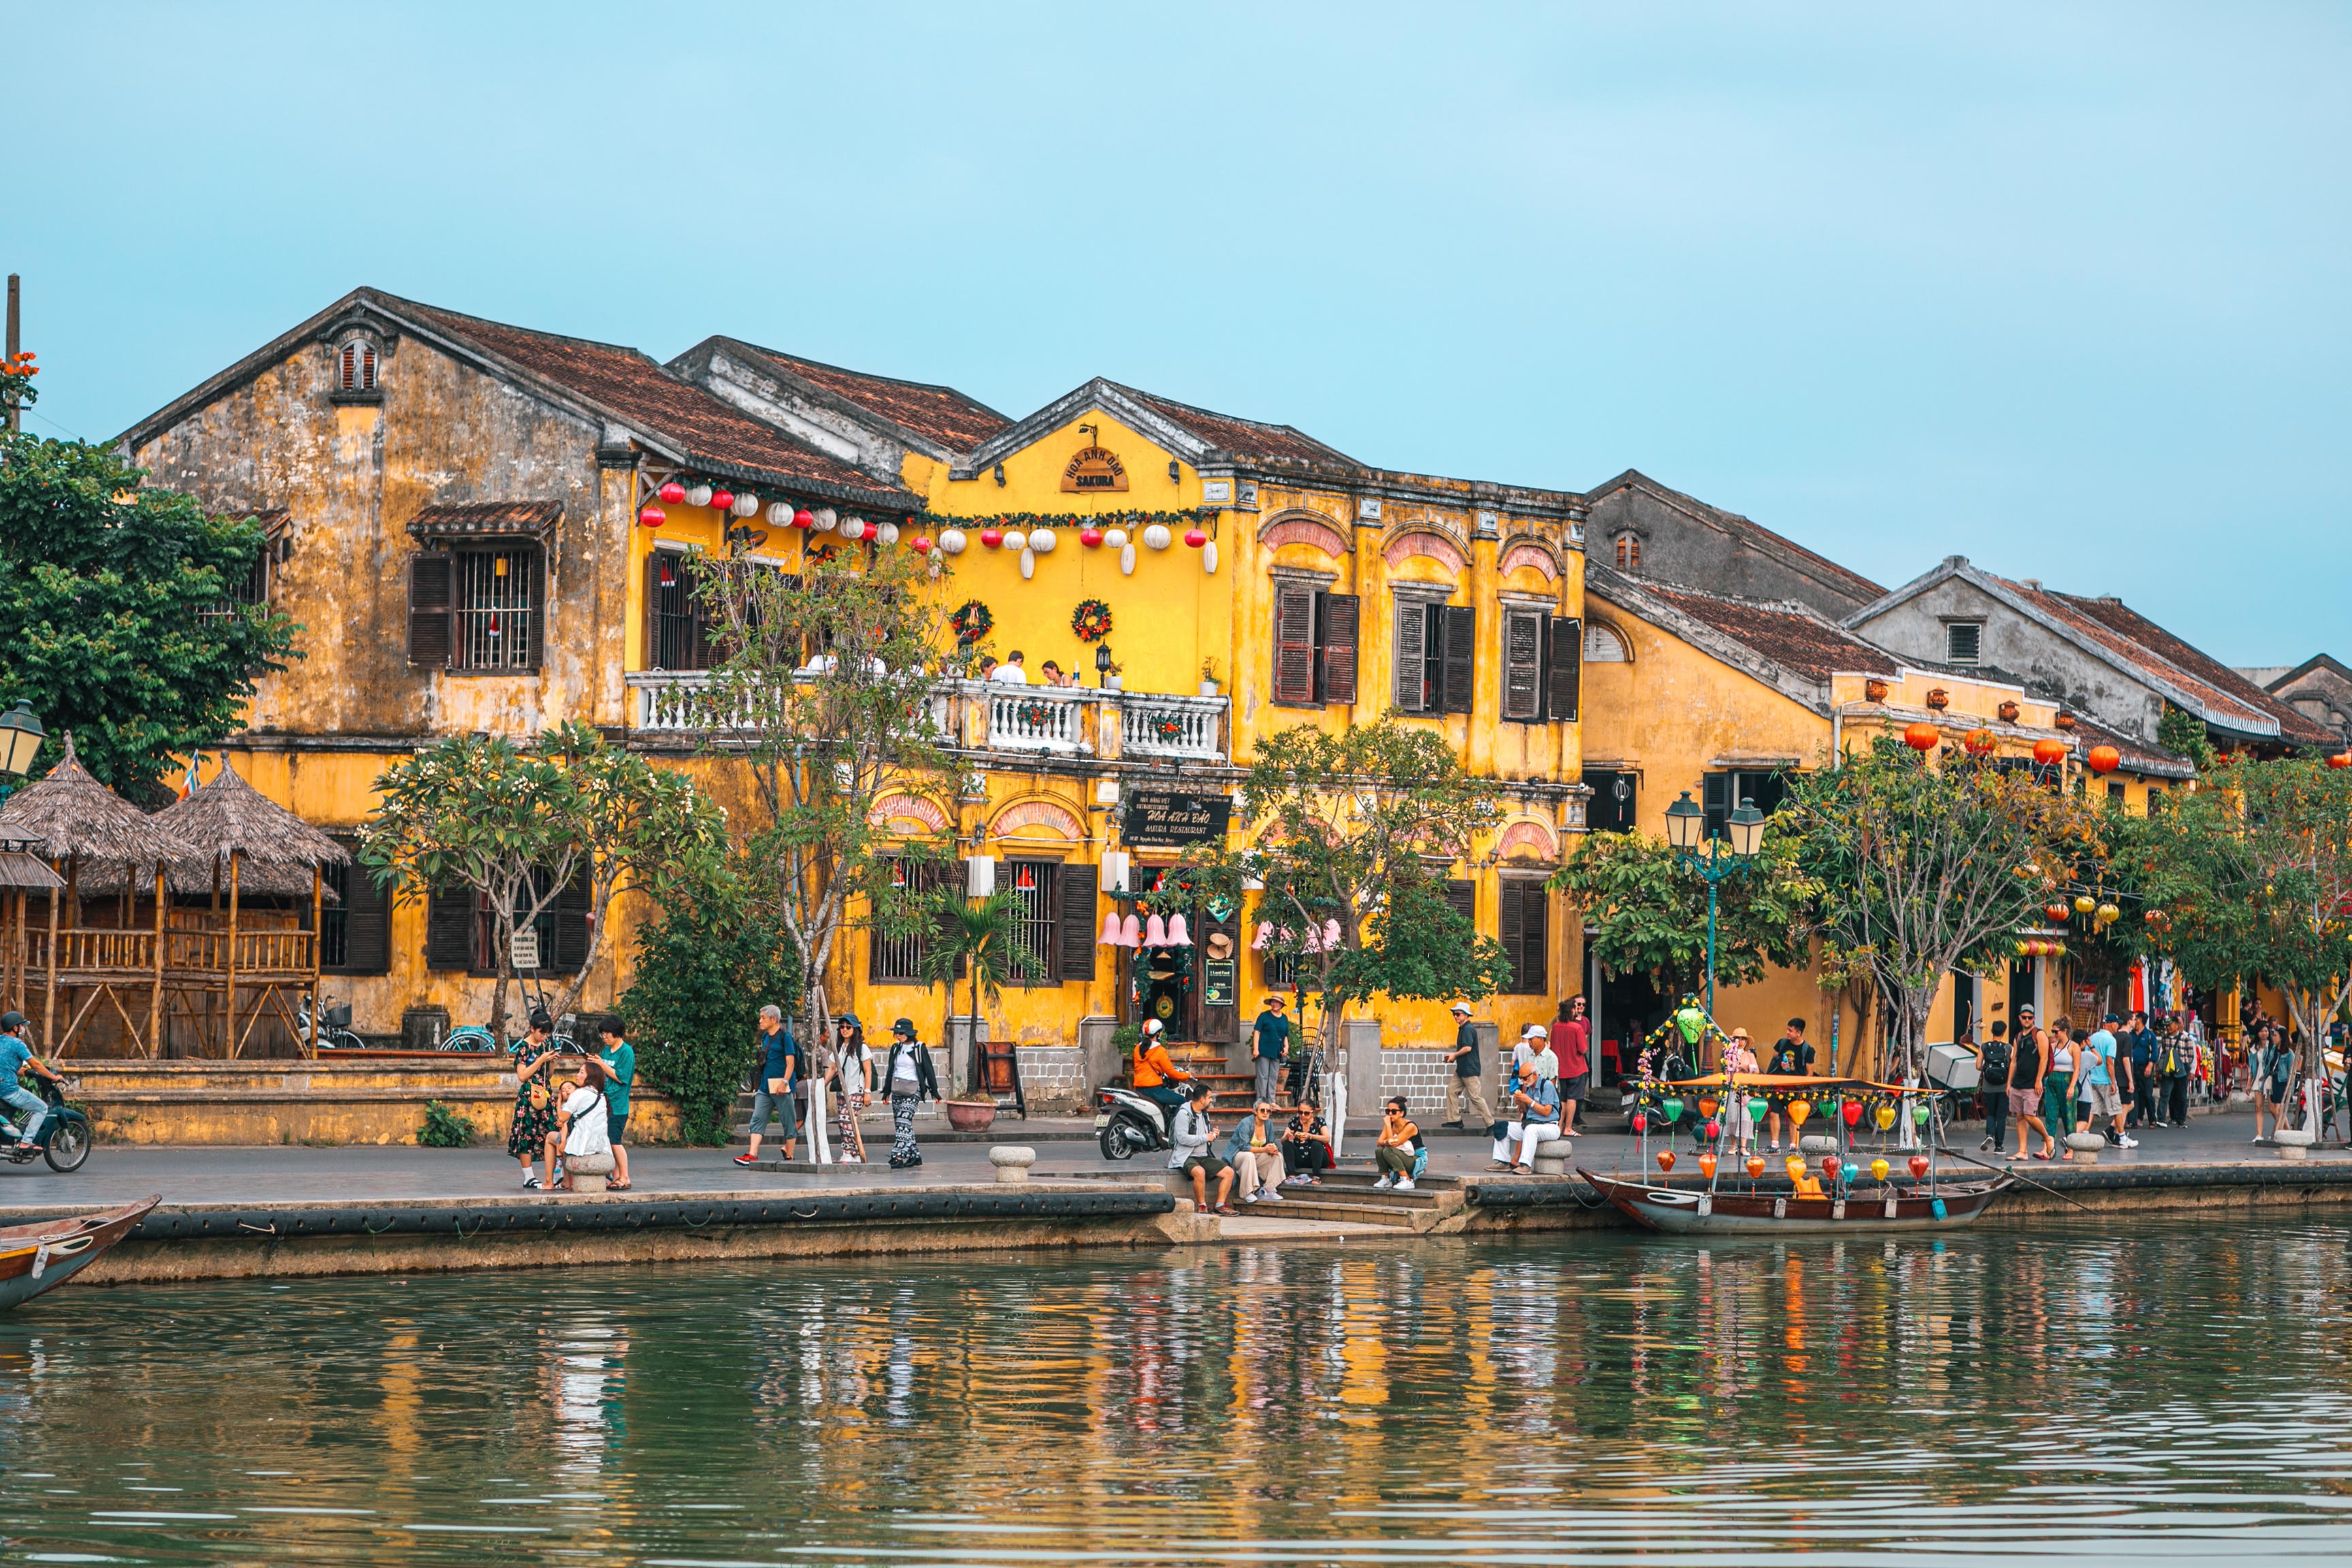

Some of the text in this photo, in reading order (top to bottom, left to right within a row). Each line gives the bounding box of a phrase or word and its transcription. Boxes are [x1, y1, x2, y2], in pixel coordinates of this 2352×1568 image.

[1066, 449, 1123, 479] HOA ANH DAO
[1076, 475, 1114, 487] SAKURA
[1147, 810, 1166, 821] HOA
[1167, 811, 1190, 822] ANH
[1170, 826, 1207, 834] RESTAURANT
